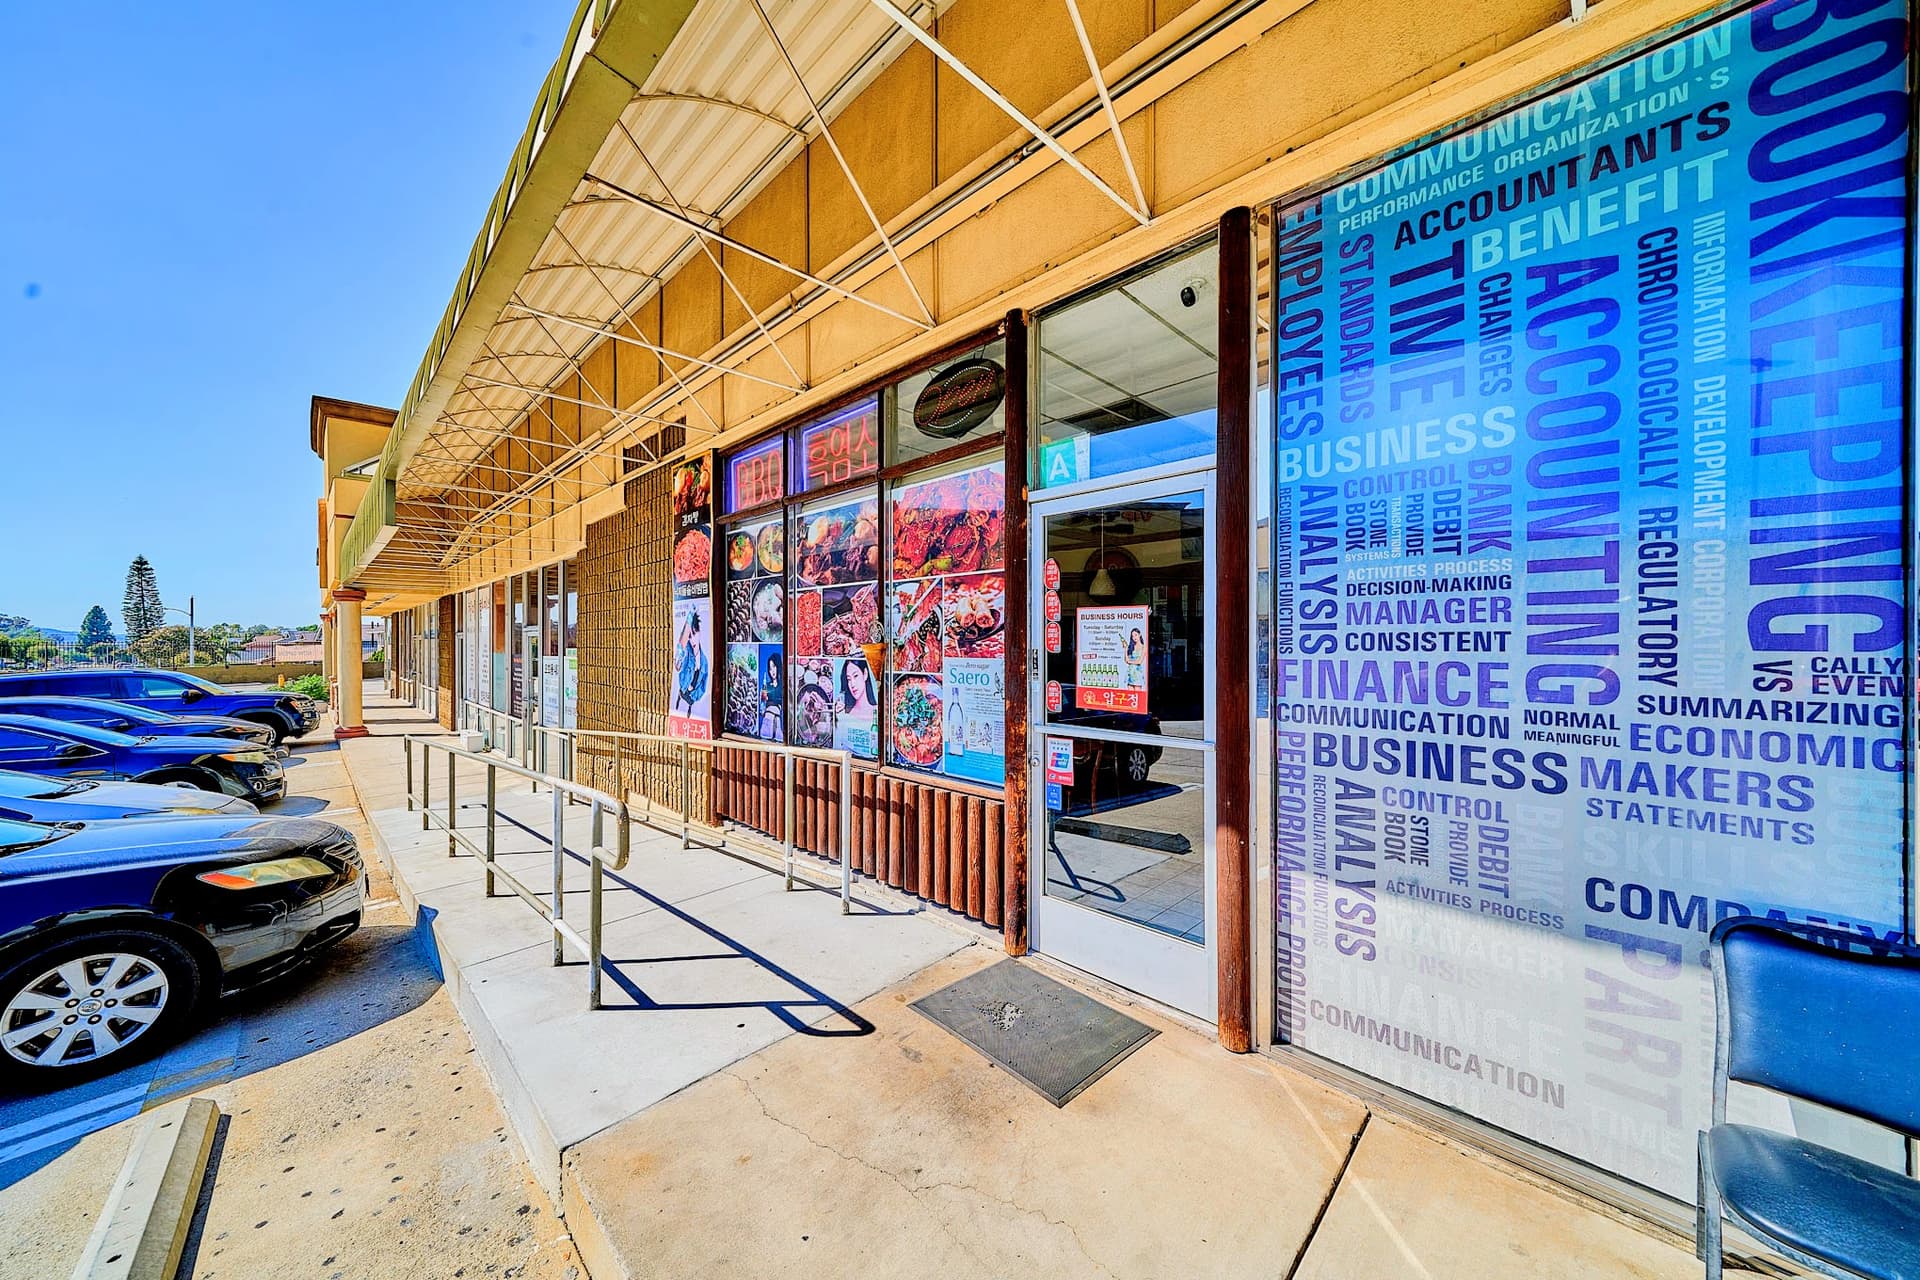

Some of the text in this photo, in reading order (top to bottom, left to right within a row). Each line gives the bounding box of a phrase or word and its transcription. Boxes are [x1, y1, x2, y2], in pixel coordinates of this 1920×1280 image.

[1336, 20, 1732, 213] COMMUNICATION
[1338, 165, 1484, 236] PERFORMANCE
[1393, 101, 1731, 251] ACCOUNTANTS
[1471, 149, 1729, 273] BENEFIT
[1279, 197, 1324, 441] EMPLOYEES
[1339, 233, 1374, 424] STANDARDS
[1389, 239, 1465, 412] TIME
[1478, 272, 1513, 397] CHANGES
[1748, 0, 1908, 652] BOOKKEEPING
[1050, 452, 1070, 481] A
[1279, 405, 1516, 483] BUSINESS
[1637, 226, 1679, 688] CHRONOLOGICALLY REGULATORY
[1692, 210, 1727, 689] INFORMATION DEVELOPMENT CORPORATION
[1343, 463, 1462, 499] CONTROL
[1467, 455, 1513, 555] BANK
[1525, 253, 1622, 706] ACCOUNTING
[1345, 501, 1366, 552] BOOK
[1369, 499, 1387, 549] STONE
[1406, 492, 1425, 557] PROVIDE
[1432, 487, 1462, 556] DEBIT
[1279, 486, 1294, 655] RECONCILIATION FUNCTIONS
[1299, 483, 1338, 655] ANALYSIS
[1344, 550, 1390, 562] SYSTEMS
[1345, 574, 1512, 597] DECISION-MAKING
[1346, 557, 1513, 582] ACTIVITIES PROCESS
[1080, 612, 1144, 621] BUSINESS HOURS
[1345, 596, 1512, 626] MANAGER
[1345, 630, 1512, 653] CONSISTENT
[949, 667, 990, 686] Saero
[1103, 691, 1139, 708] 압구정
[1277, 658, 1510, 709] FINANCE
[1752, 656, 1905, 693] VS CALLY
[1276, 702, 1510, 740] COMMUNICATION
[1523, 708, 1621, 731] NORMAL
[1523, 730, 1621, 748] MEANINGFUL
[1636, 694, 1901, 728] SUMMARIZING
[1313, 732, 1568, 795] BUSINESS
[1629, 722, 1905, 773] ECONOMIC
[1382, 785, 1510, 824] CONTROL
[1580, 755, 1815, 813] MAKERS
[1383, 810, 1406, 865] BOOK
[1410, 814, 1430, 868] STONE
[1585, 797, 1815, 846] STATEMENTS
[1312, 774, 1329, 949] RECONCILIATION FUNCTIONS
[1335, 776, 1377, 962] ANALYSIS
[1449, 819, 1469, 888] PROVIDE
[1478, 824, 1511, 899] DEBIT
[1277, 730, 1306, 1050] PERFORMANCE PROVIDE
[1386, 879, 1566, 930] ACTIVITIES PROCESS
[1309, 999, 1566, 1109] COMMUNICATION
[1584, 923, 1683, 1130] PART
